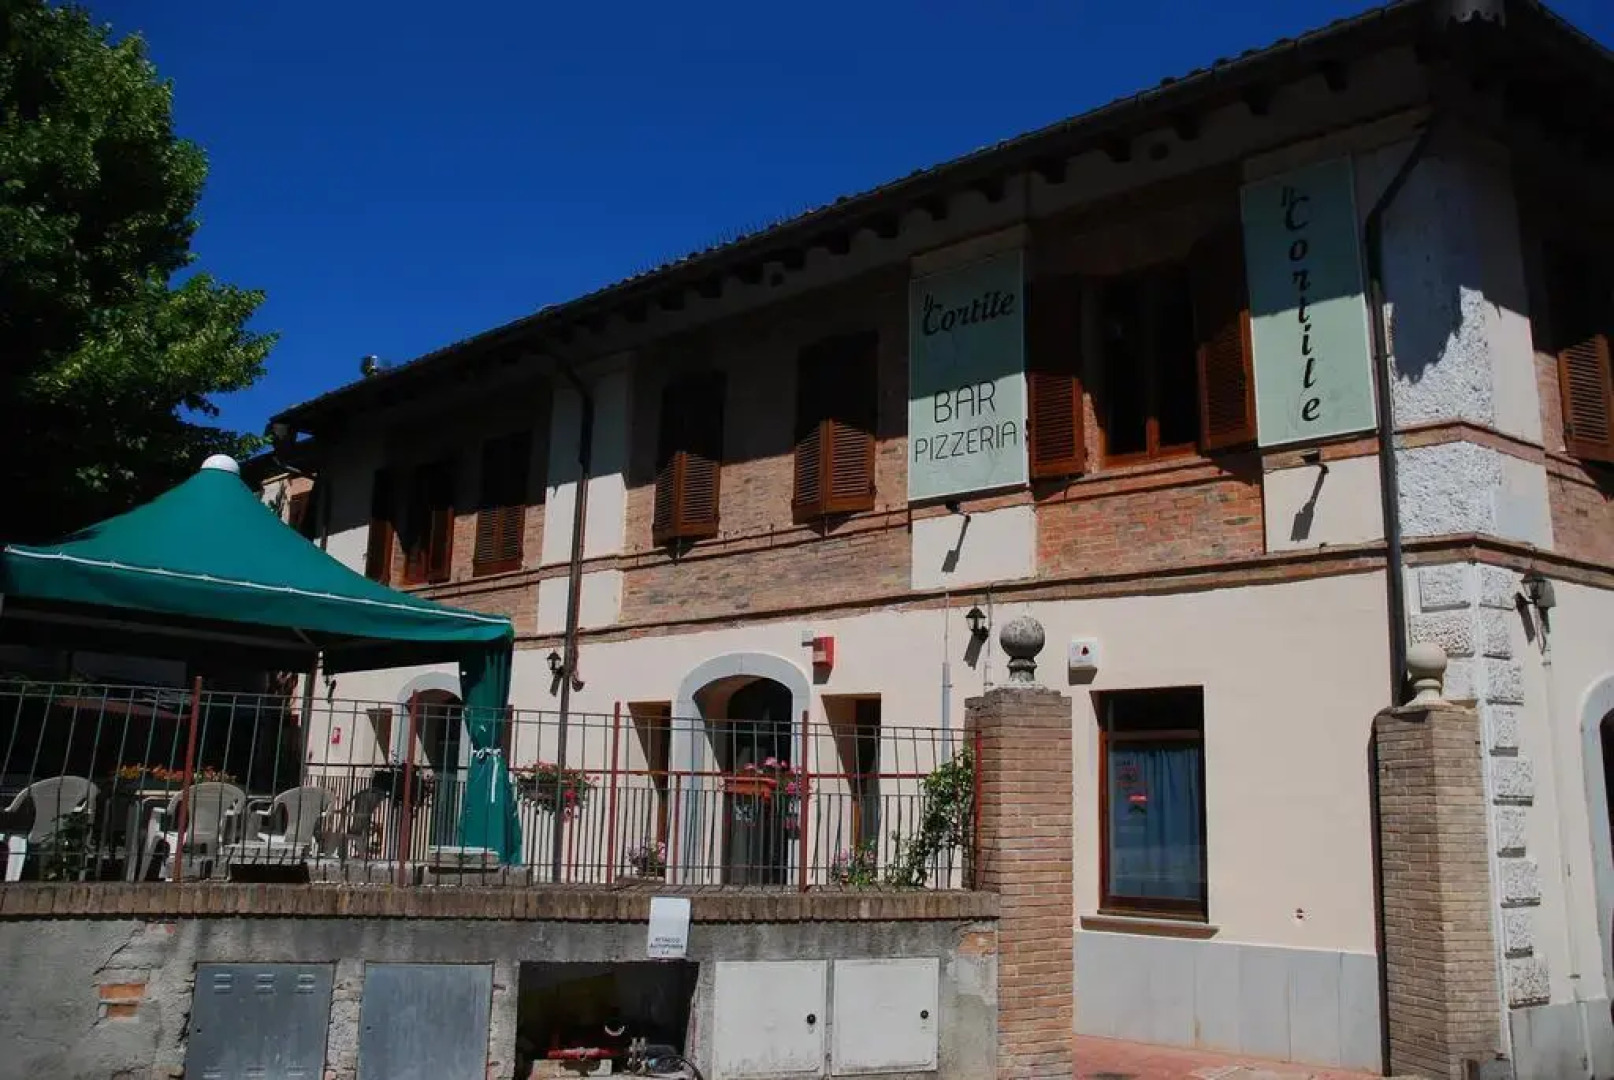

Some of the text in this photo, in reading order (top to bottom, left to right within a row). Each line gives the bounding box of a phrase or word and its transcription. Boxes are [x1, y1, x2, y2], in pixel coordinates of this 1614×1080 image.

[923, 291, 1015, 336] Cortile
[1284, 196, 1320, 422] Cortile
[934, 380, 996, 423] BAR
[915, 421, 1017, 463] PIZZERIA
